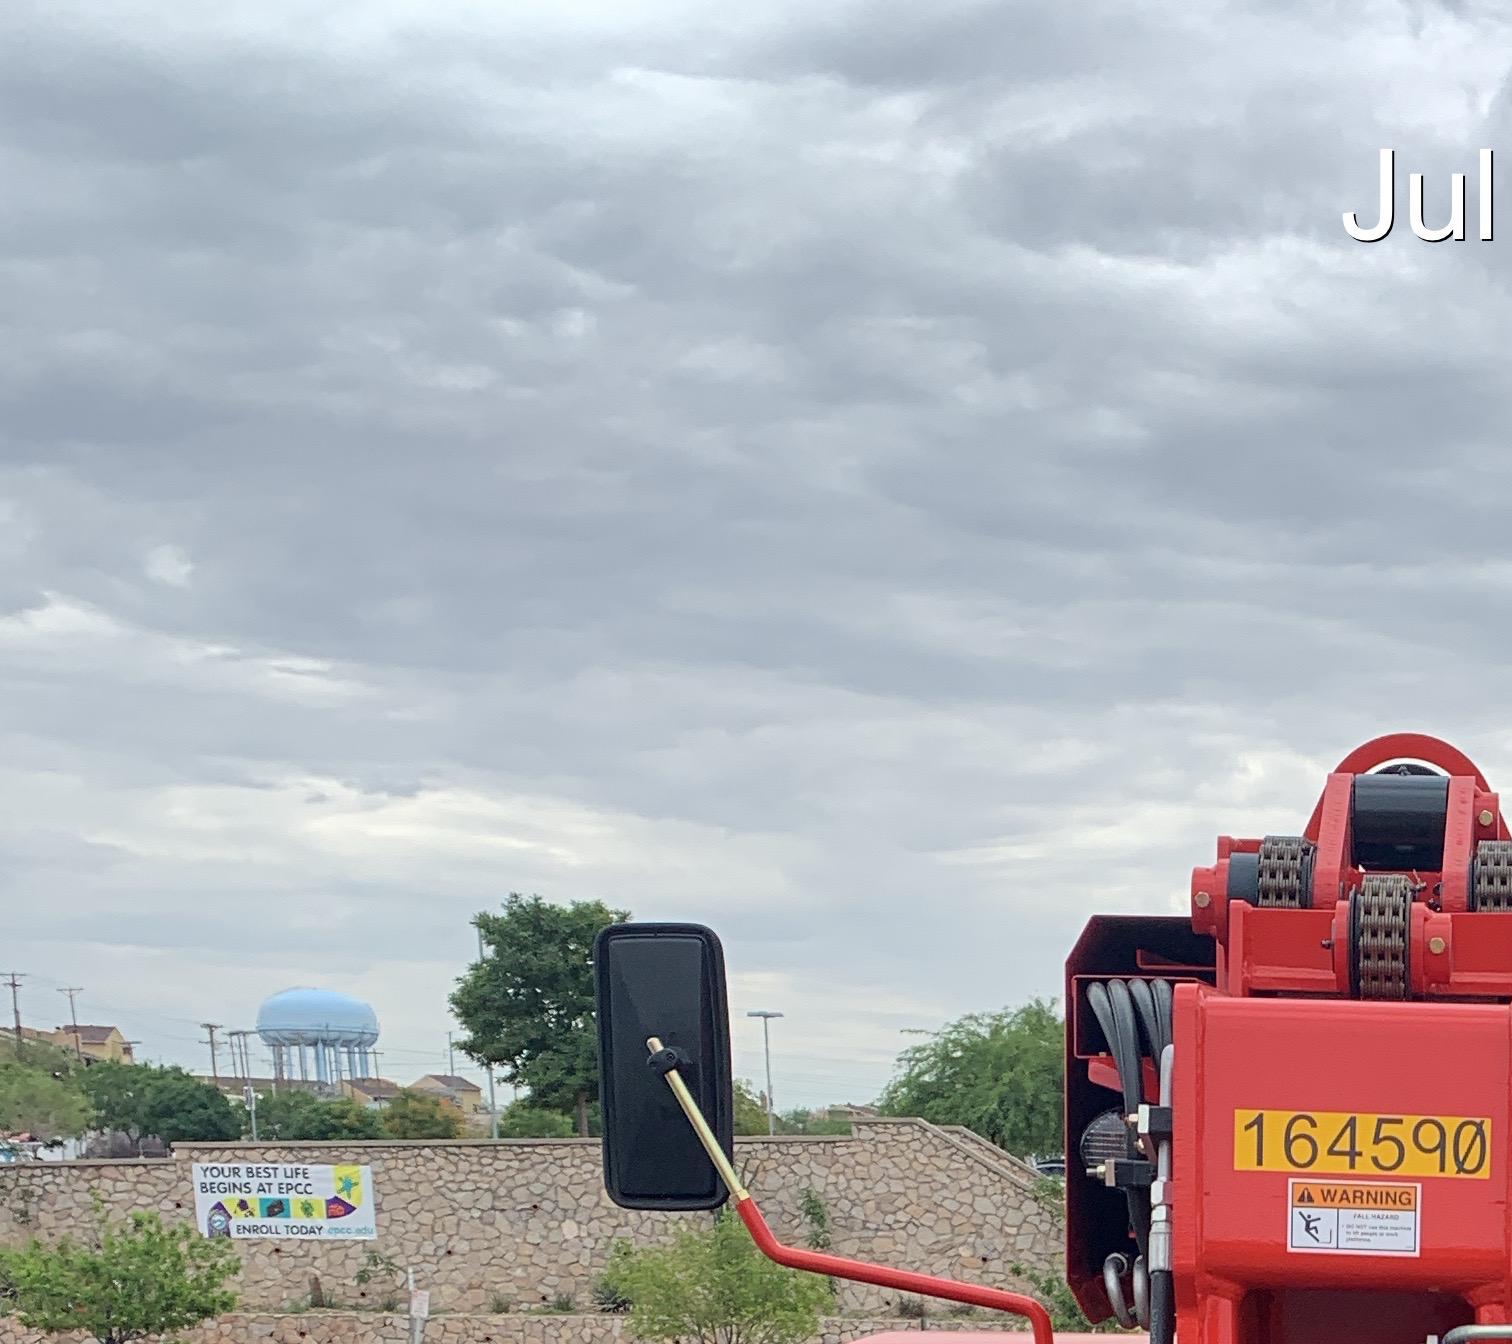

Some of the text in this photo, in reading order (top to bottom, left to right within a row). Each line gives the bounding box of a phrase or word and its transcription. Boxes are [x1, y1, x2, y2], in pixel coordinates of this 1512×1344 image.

[1244, 1112, 1487, 1175] 164590
[200, 1166, 309, 1179] YOUR BEST LIFE
[200, 1182, 313, 1195] BEGINS AT EPCC
[1320, 1188, 1412, 1206] WARNING
[236, 1224, 374, 1237] ENROLL TODAY epcc.edu
